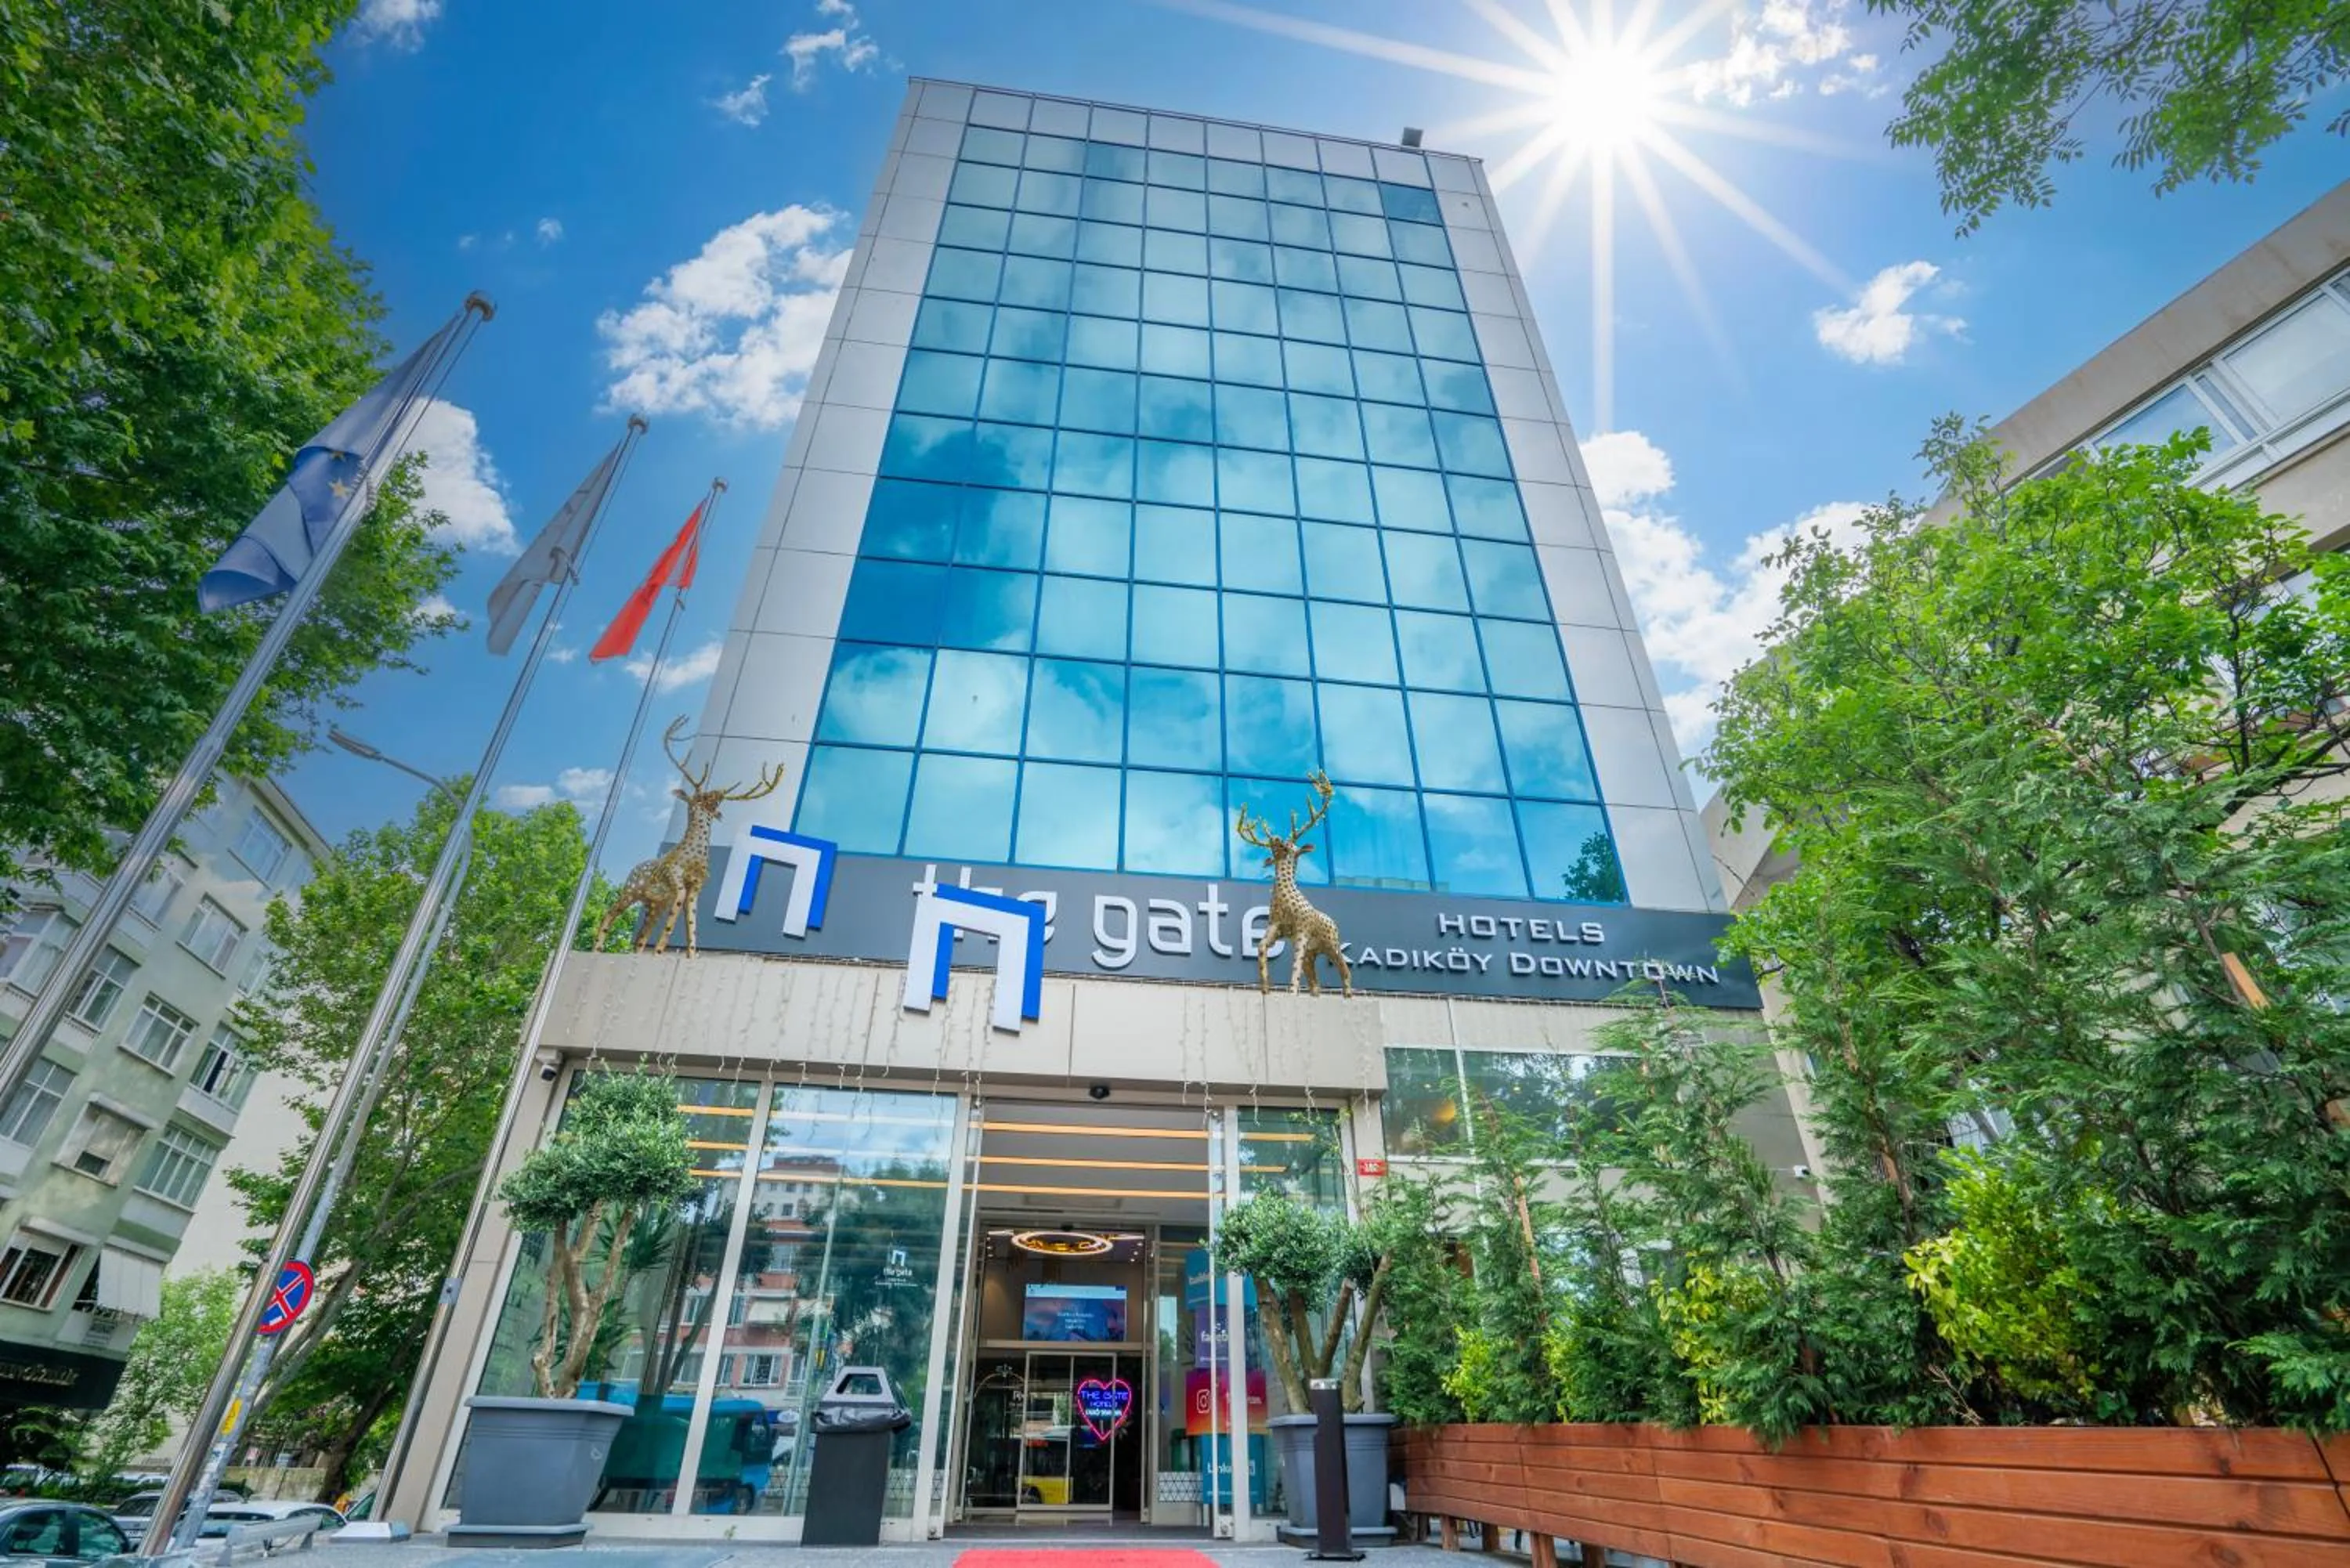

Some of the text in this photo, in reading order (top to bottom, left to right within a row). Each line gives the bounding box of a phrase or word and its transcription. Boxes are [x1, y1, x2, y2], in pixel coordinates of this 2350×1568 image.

[1091, 883, 1285, 970] gate
[1438, 912, 1605, 943] HOTELS
[1509, 952, 1719, 984] DOWNTOWN
[1081, 1390, 1101, 1400] THE
